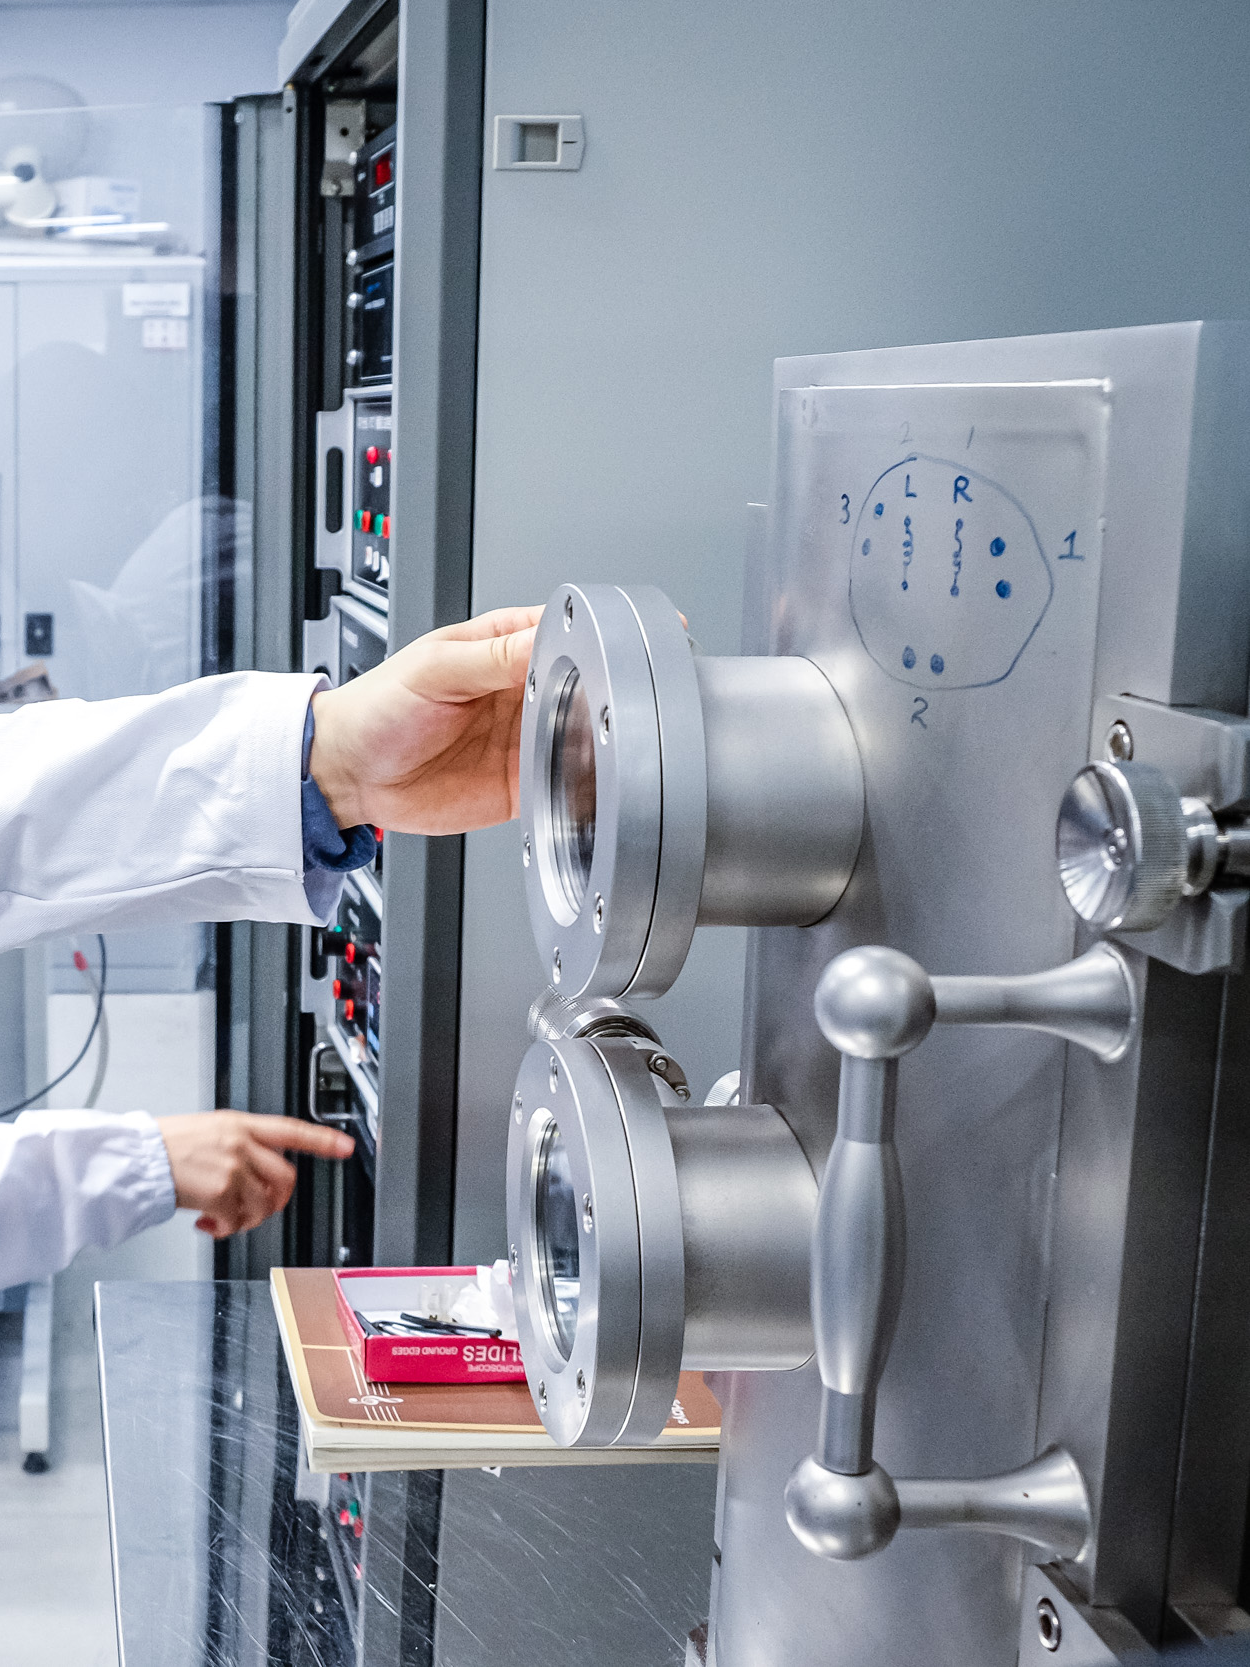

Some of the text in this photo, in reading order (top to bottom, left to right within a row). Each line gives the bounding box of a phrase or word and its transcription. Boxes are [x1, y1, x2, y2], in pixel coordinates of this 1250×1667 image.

[905, 474, 917, 498] L
[953, 475, 973, 503] R
[839, 493, 850, 524] 3
[1057, 530, 1085, 561] 1
[392, 1346, 421, 1356] EDGES
[422, 1346, 458, 1356] GROUND
